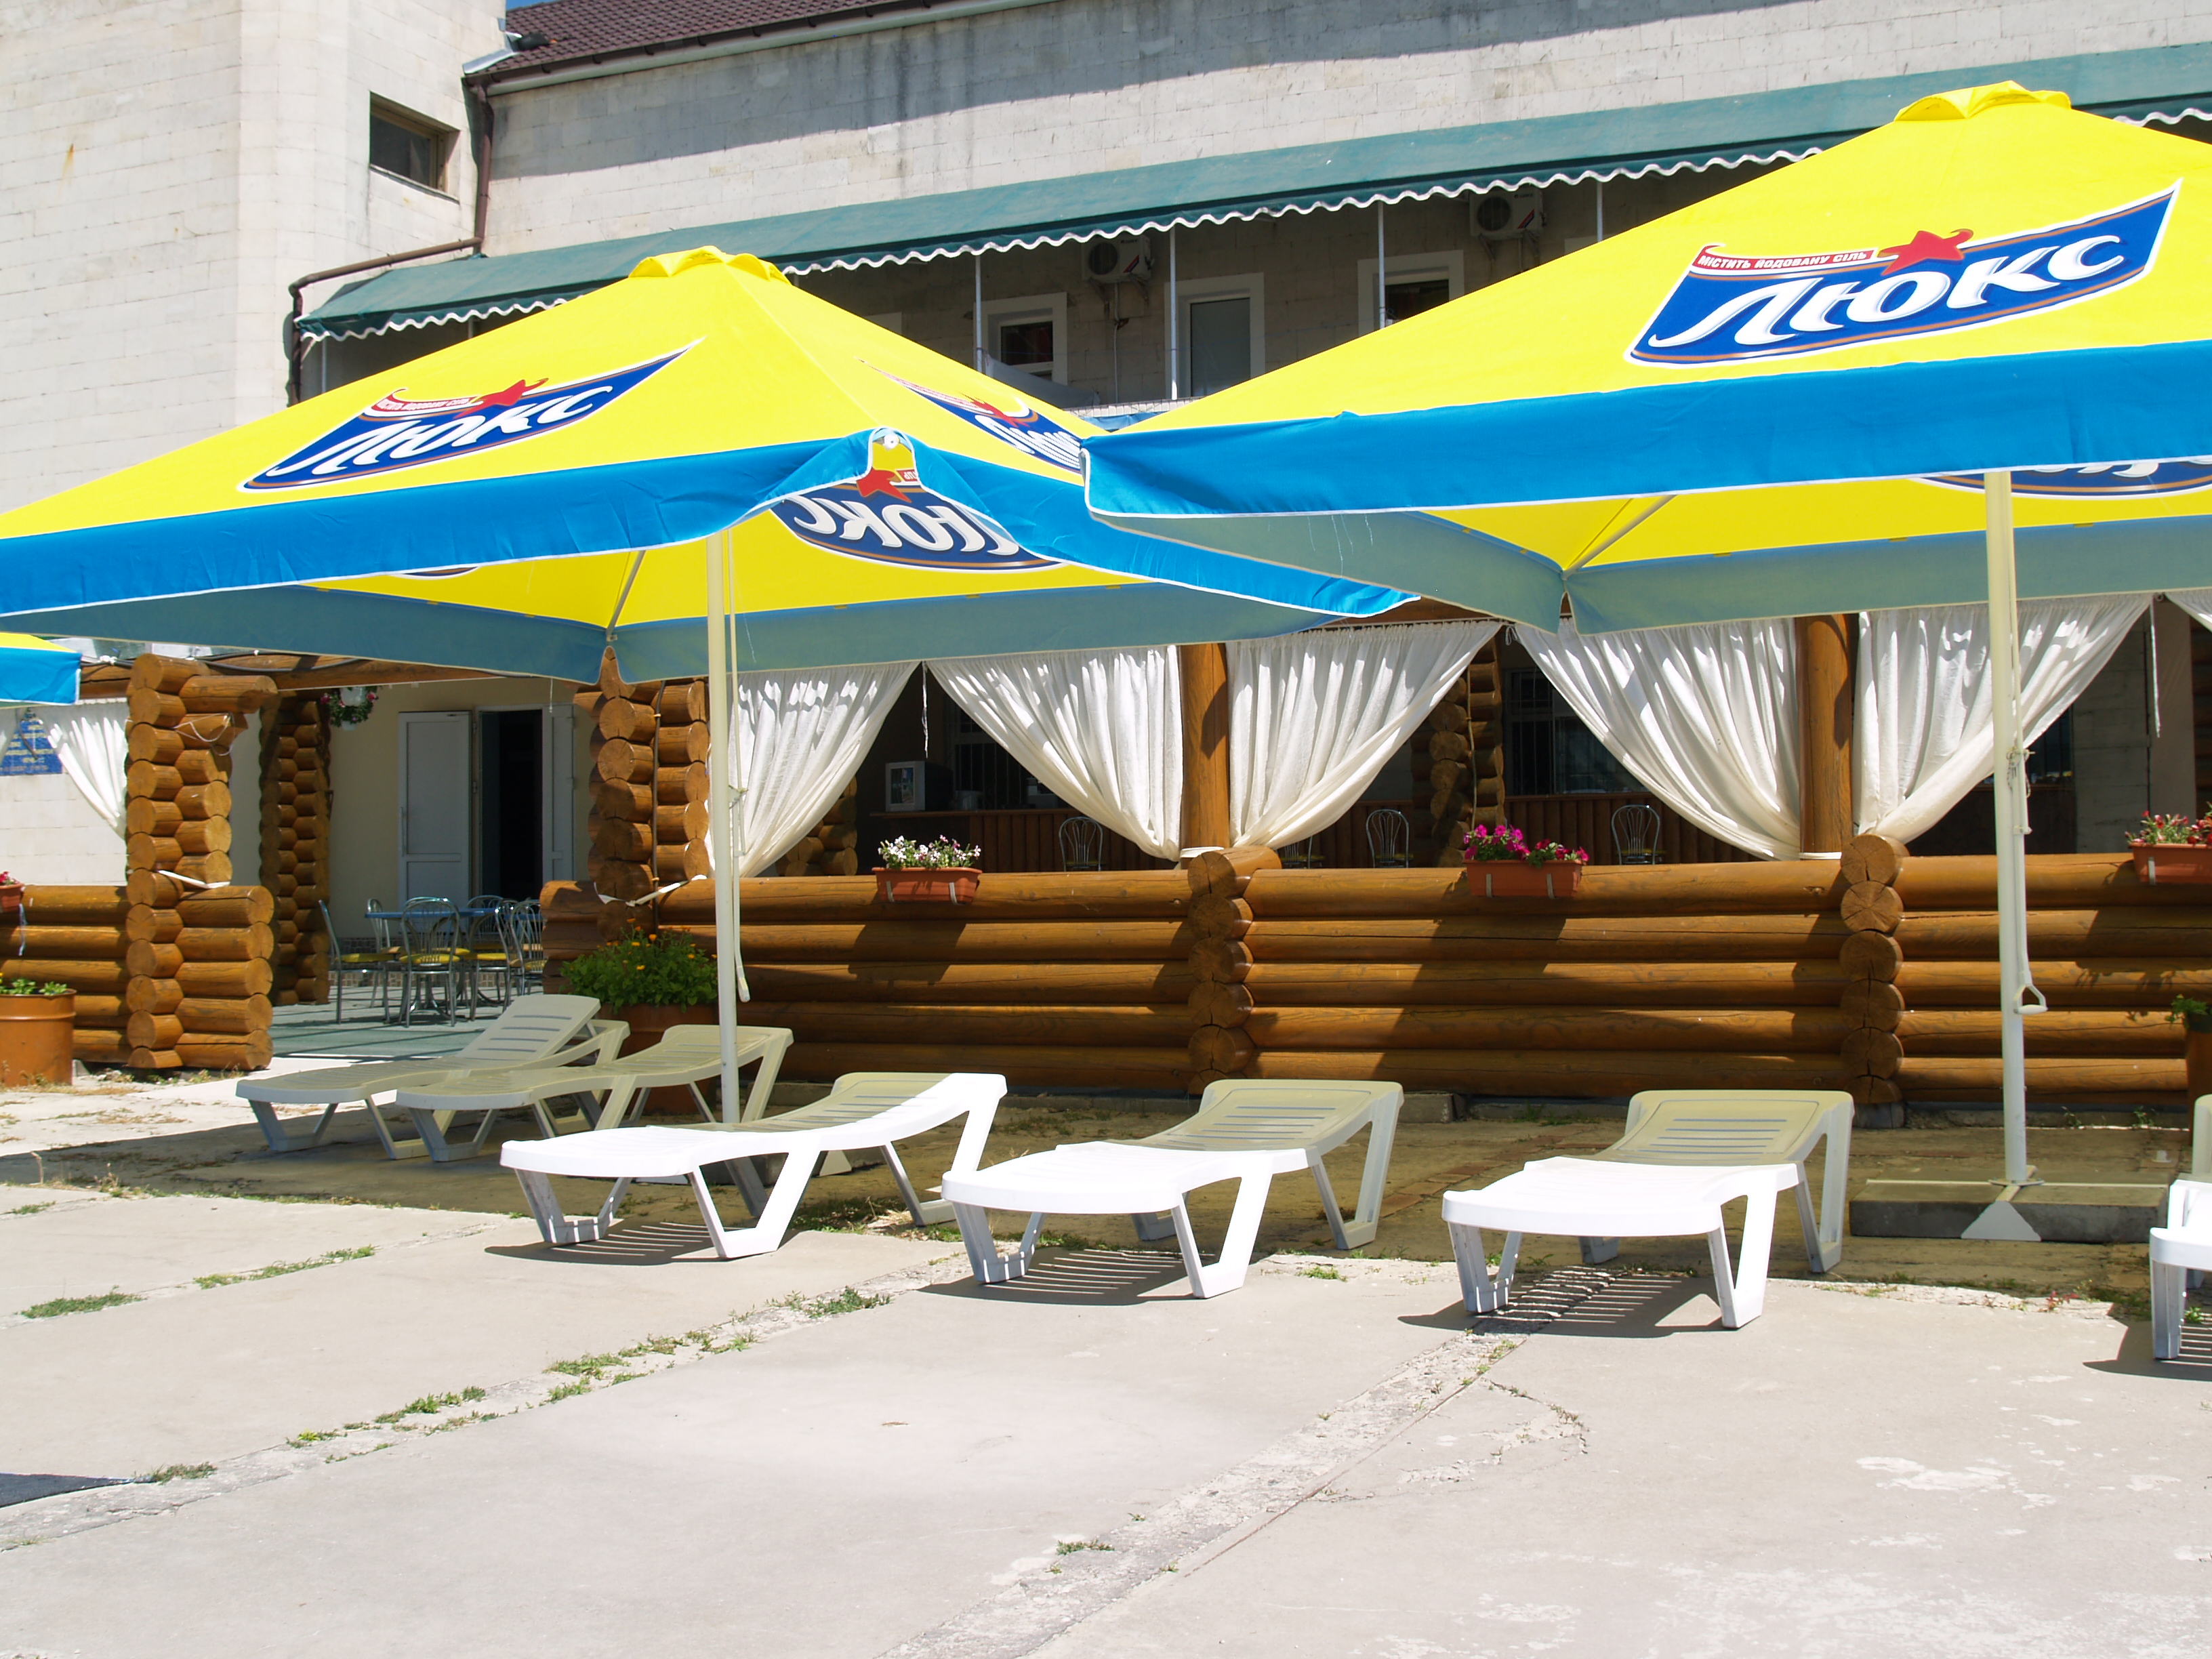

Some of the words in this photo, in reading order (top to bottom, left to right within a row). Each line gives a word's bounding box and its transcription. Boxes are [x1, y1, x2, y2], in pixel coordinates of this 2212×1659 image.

[1698, 255, 1751, 269] МІСТИТЬ
[1754, 255, 1830, 270] ЙОДОВАНУ
[1832, 251, 1868, 263] СІЛЬ
